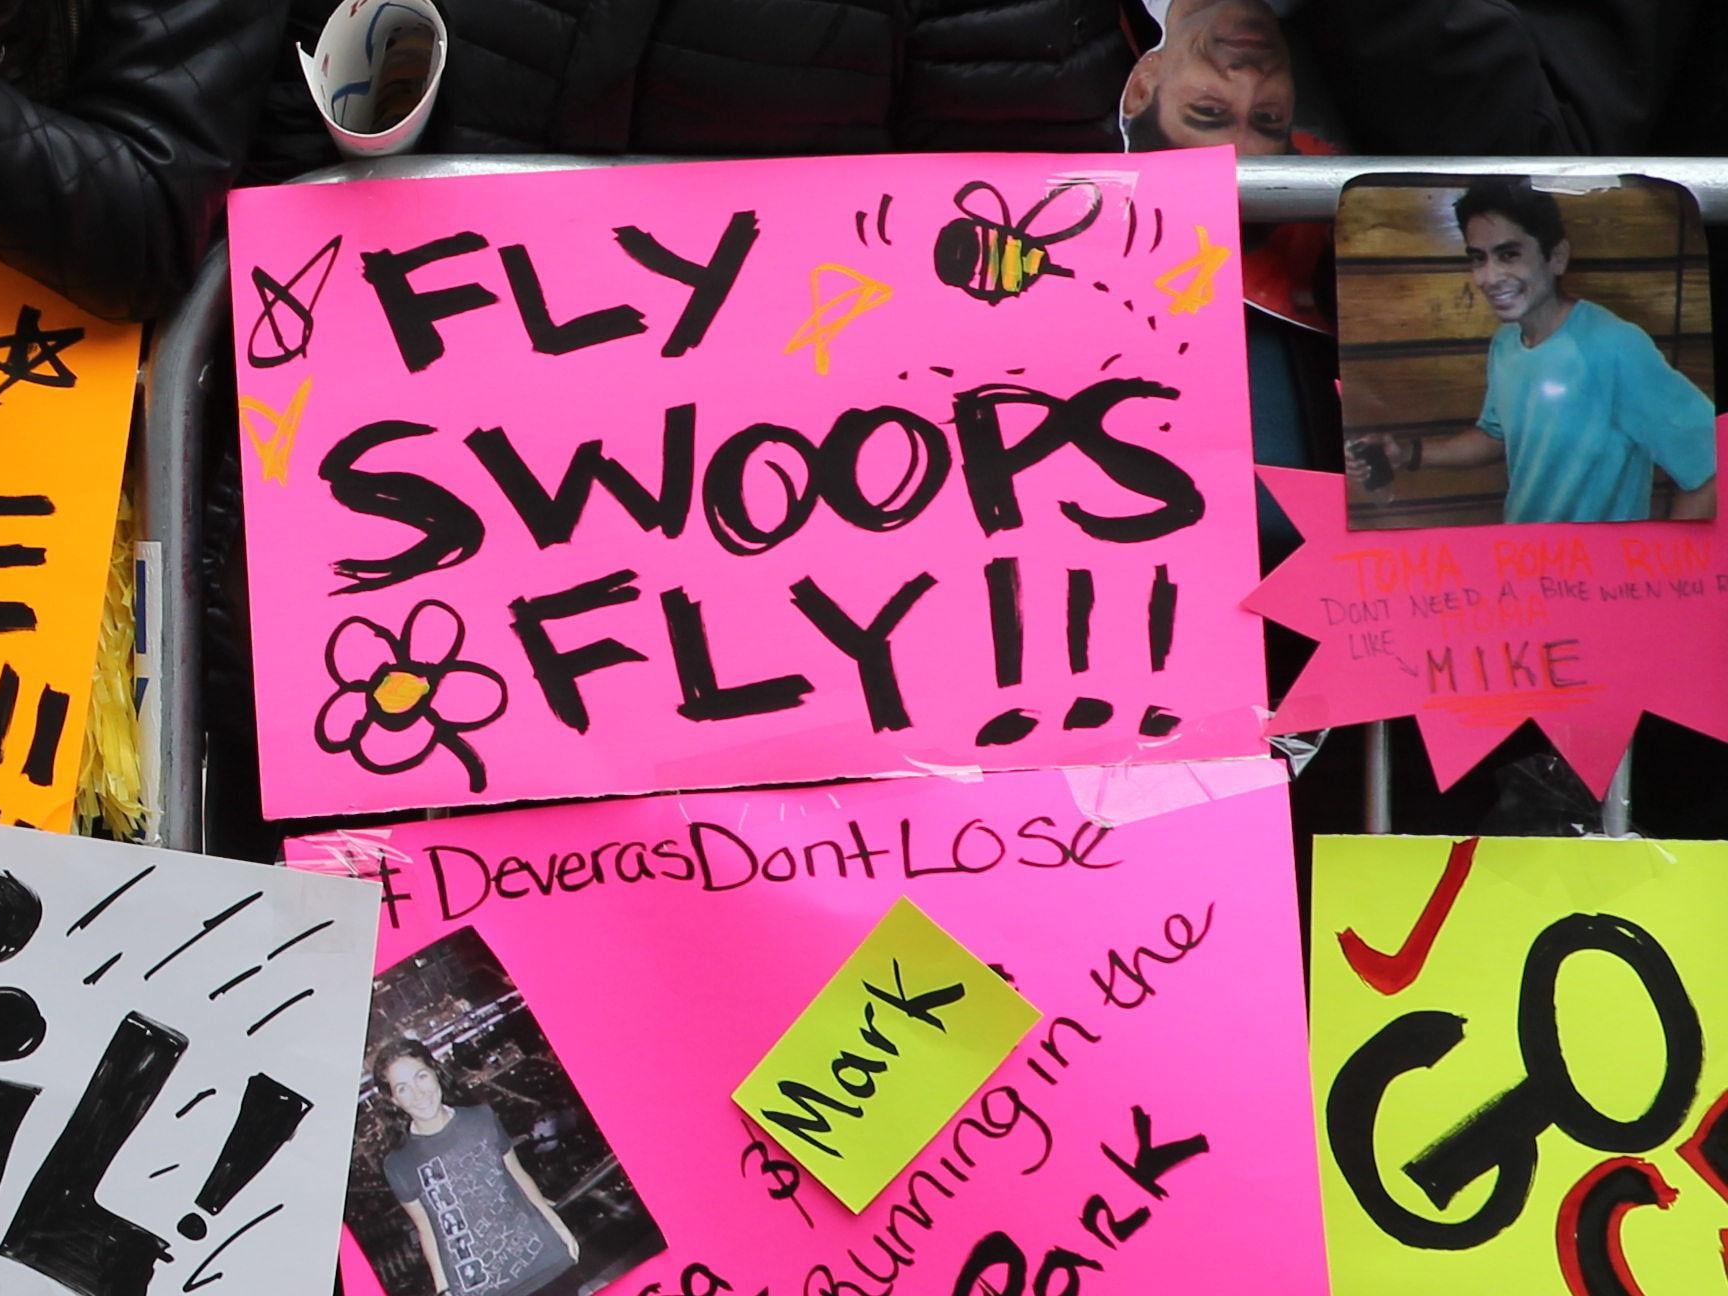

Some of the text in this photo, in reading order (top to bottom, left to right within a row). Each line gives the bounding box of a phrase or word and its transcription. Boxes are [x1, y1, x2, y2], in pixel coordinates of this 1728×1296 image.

[359, 209, 761, 375] FLY
[316, 375, 1207, 597] SWOOPS
[509, 555, 1183, 747] FLY!!!
[1320, 596, 1392, 627] DONT
[1411, 587, 1482, 620] NEED
[1497, 580, 1518, 604] A
[1539, 576, 1591, 602] BIKE
[1599, 576, 1663, 603] WHEN
[1348, 630, 1395, 661] LIKE
[1425, 638, 1589, 694] MIKE
[1026, 1016, 1102, 1085] in
[1089, 902, 1215, 1008] the
[1325, 911, 1706, 1251] GO
